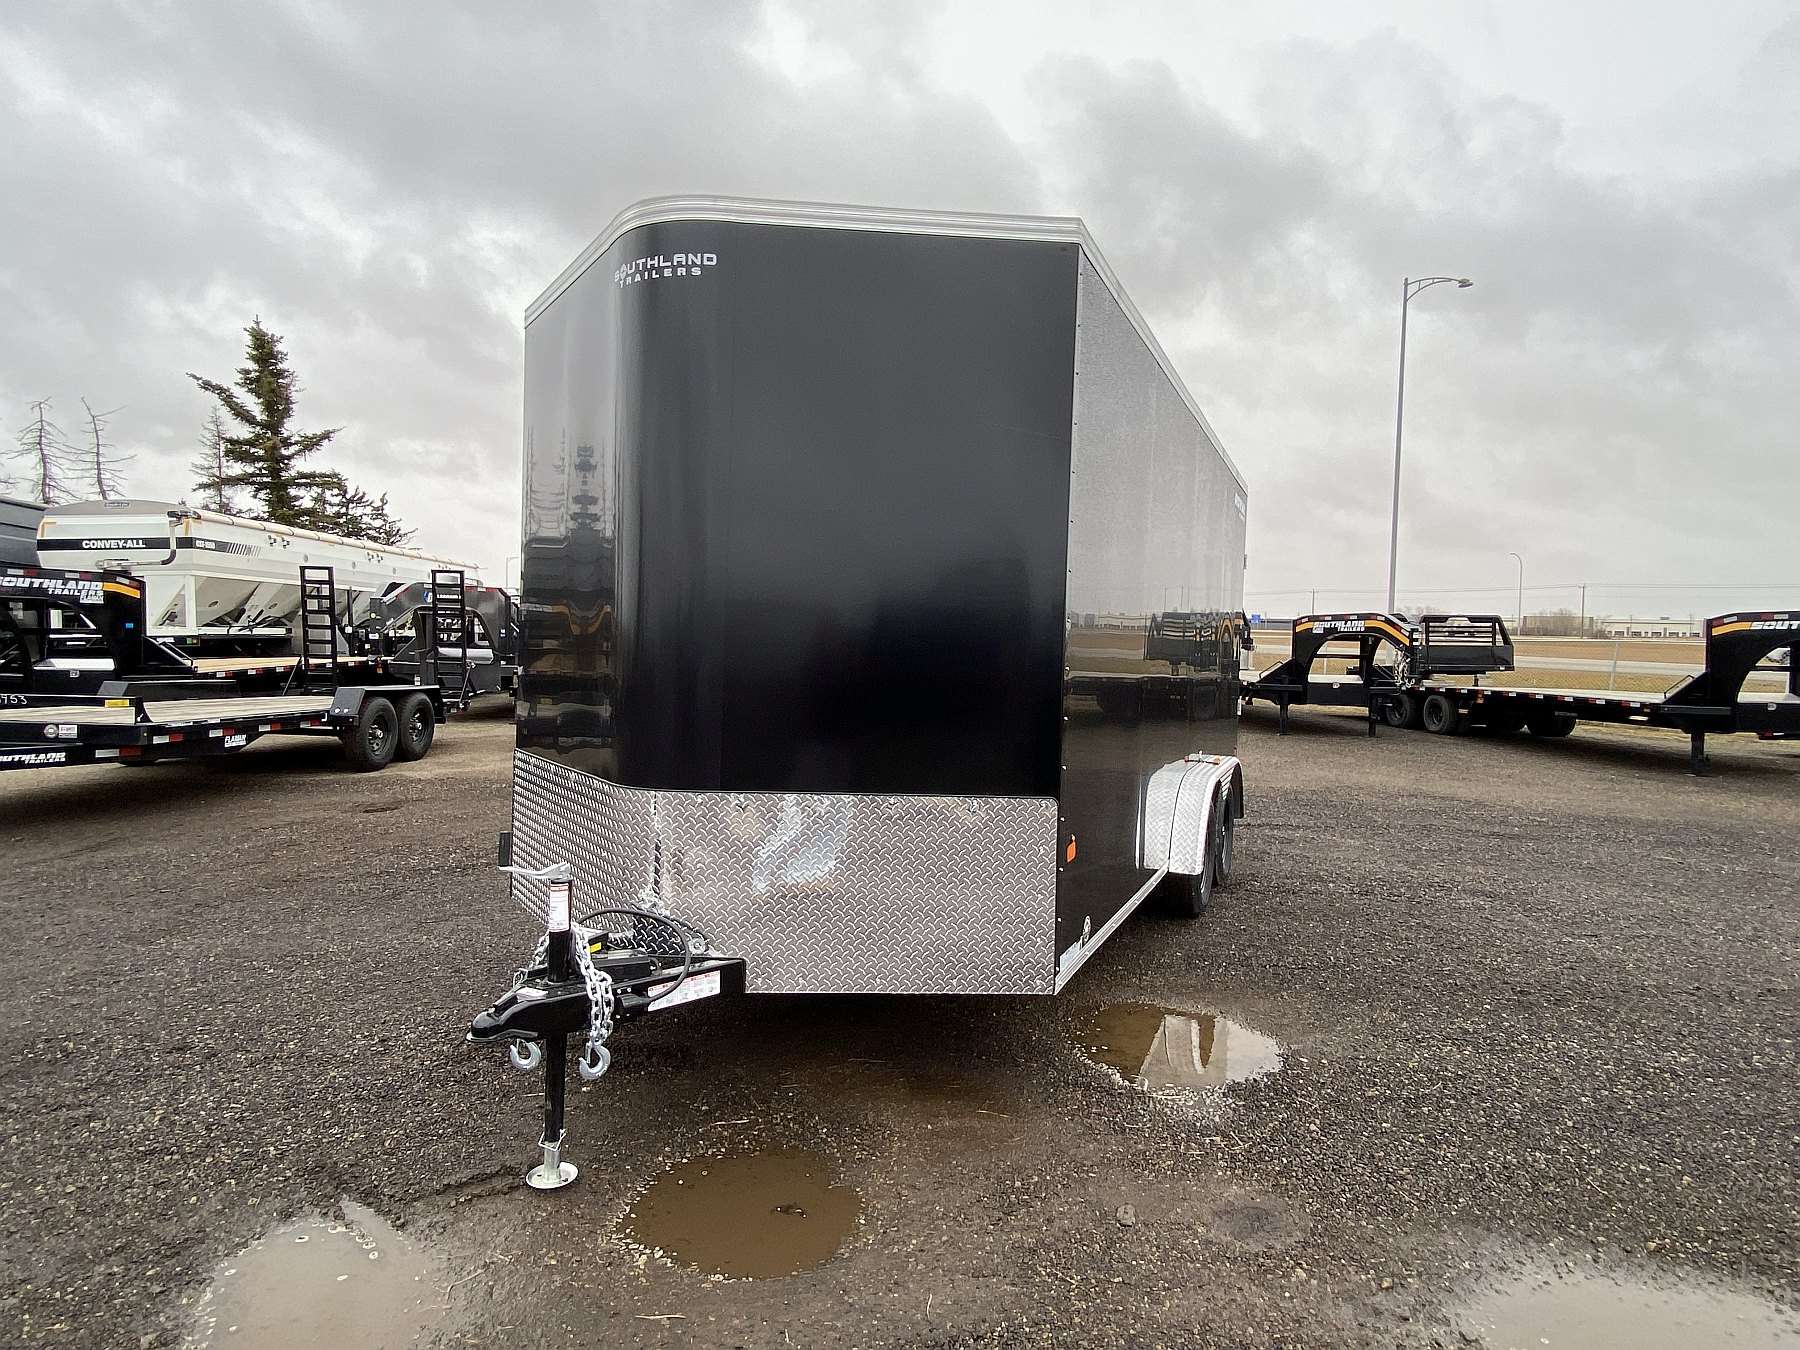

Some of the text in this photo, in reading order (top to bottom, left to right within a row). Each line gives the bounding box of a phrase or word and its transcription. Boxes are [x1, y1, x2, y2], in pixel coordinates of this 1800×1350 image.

[614, 253, 717, 281] SOUTHLAND
[619, 267, 701, 288] TRAILERS
[82, 539, 146, 549] CONVEY-ALL
